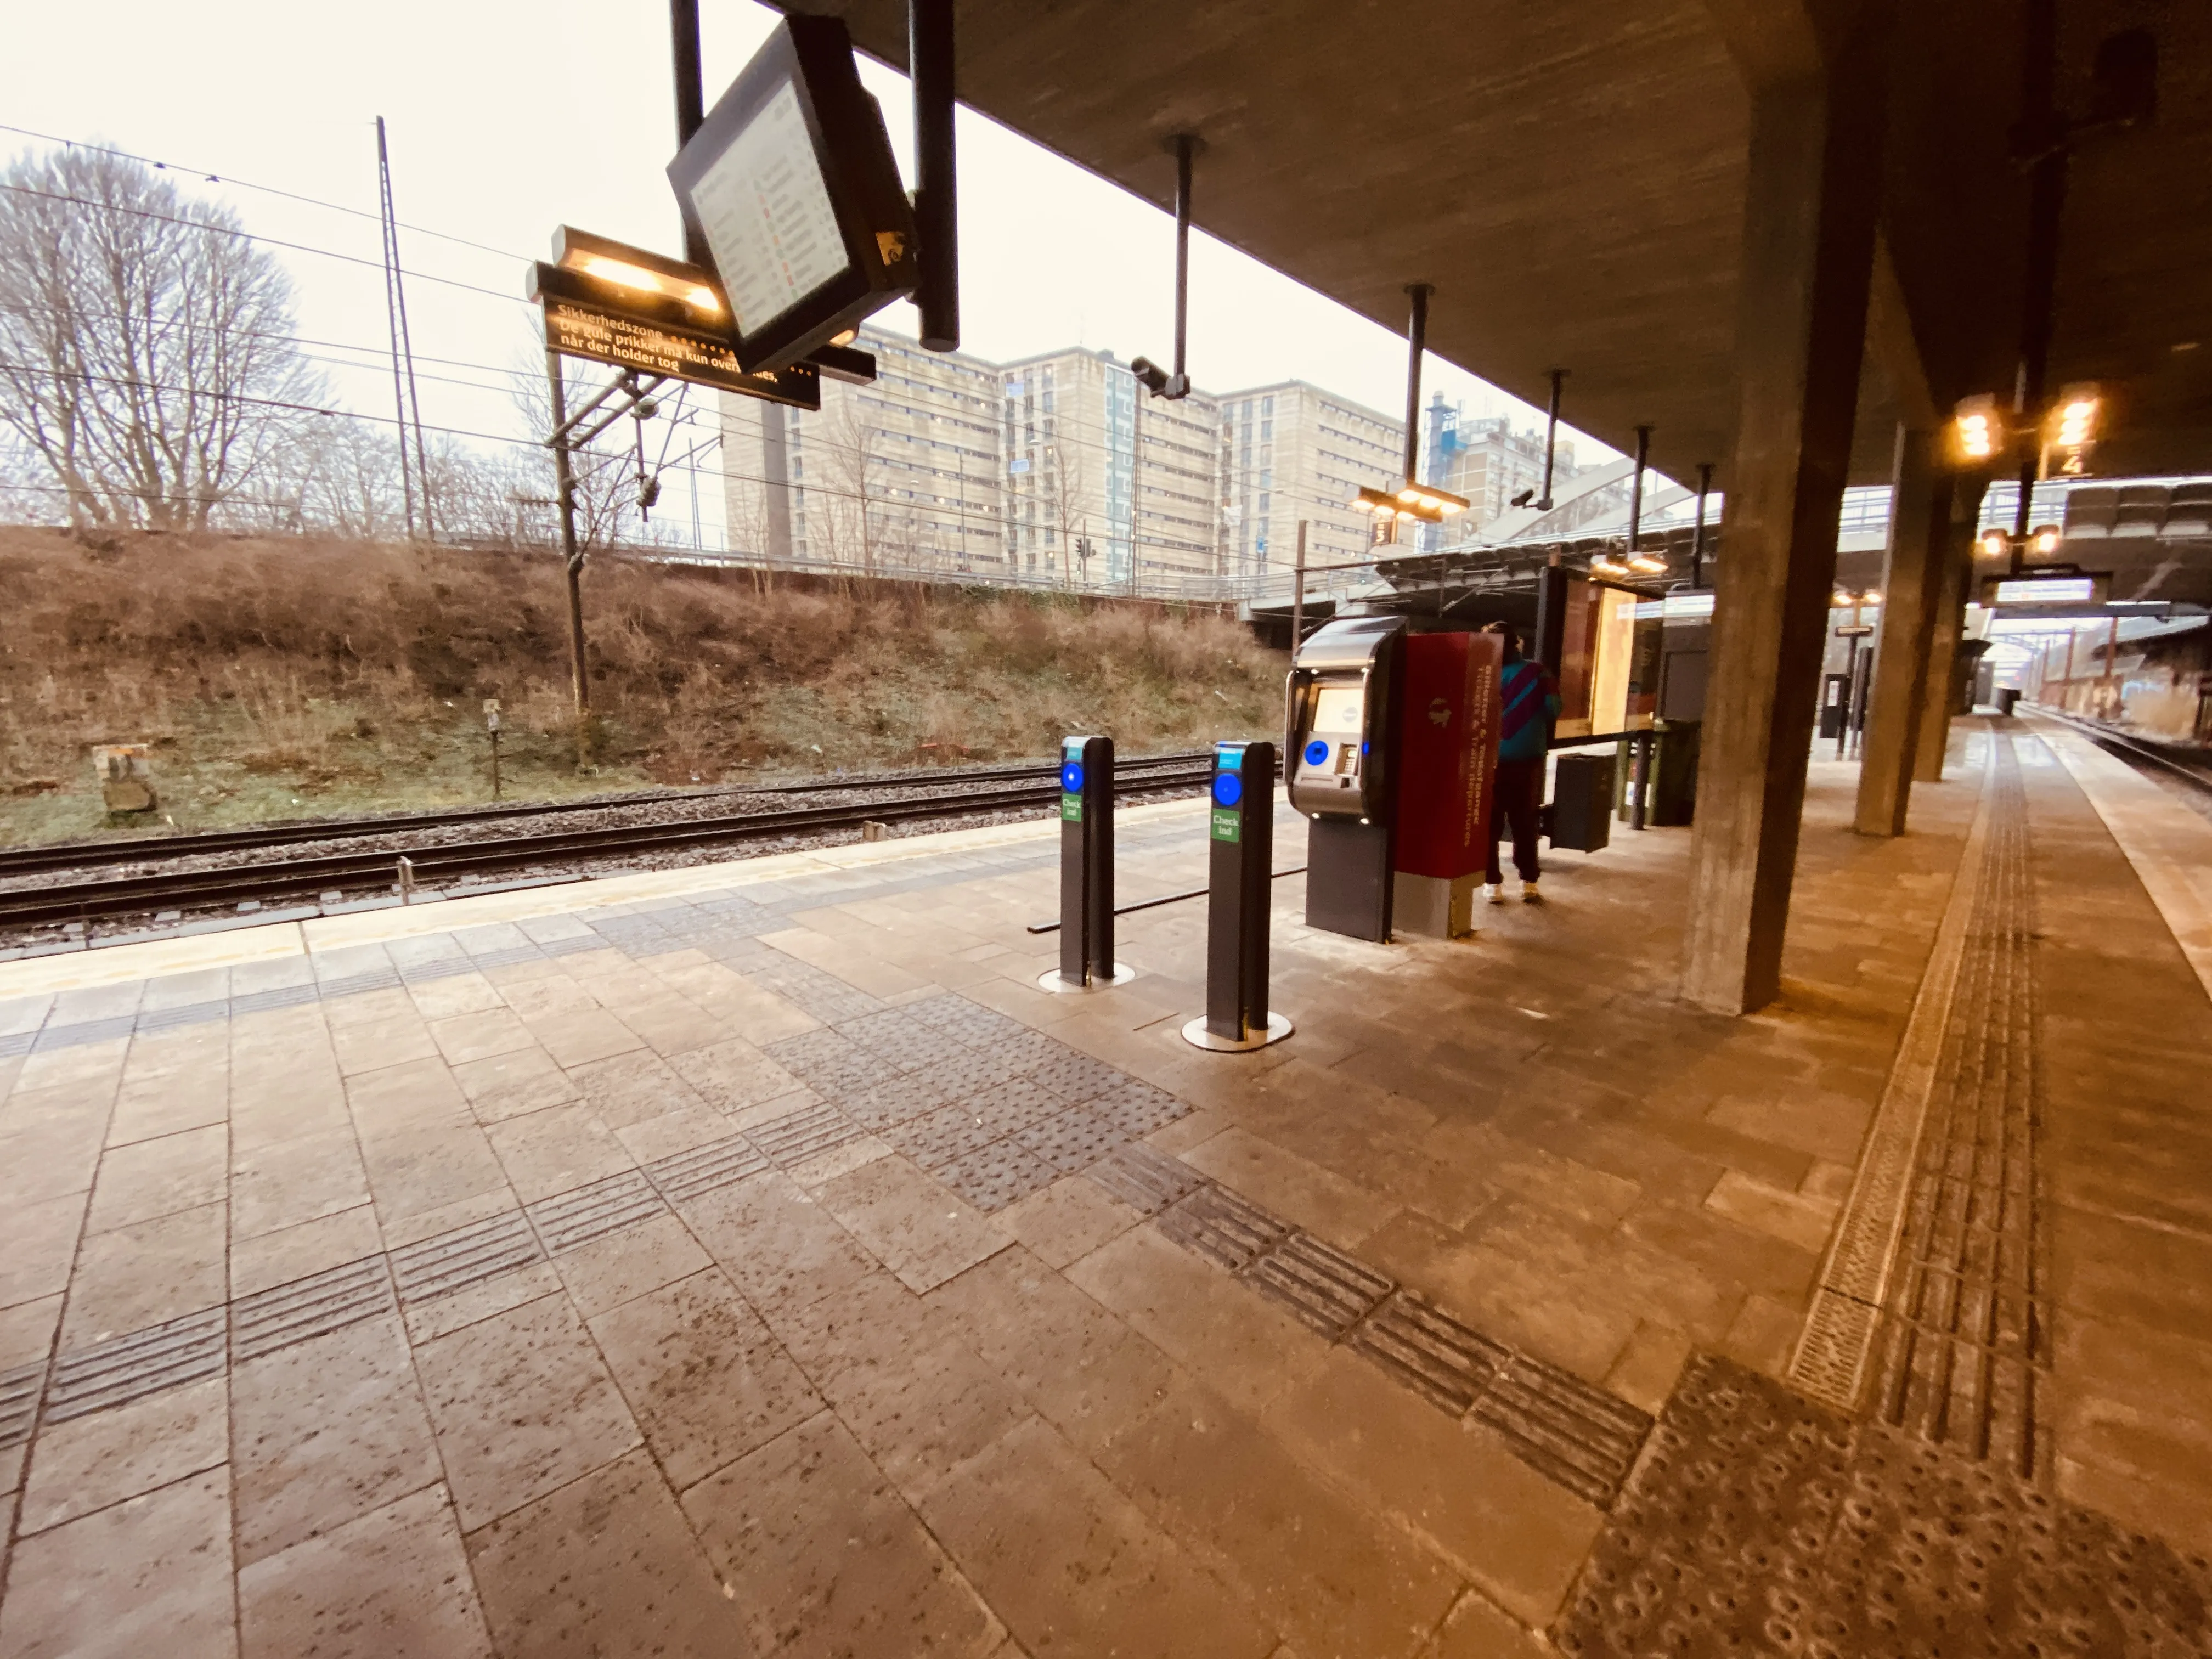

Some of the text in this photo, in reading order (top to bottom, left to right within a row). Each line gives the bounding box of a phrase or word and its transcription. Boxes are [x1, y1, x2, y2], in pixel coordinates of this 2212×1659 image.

[558, 304, 663, 339] Sikkerhedszone
[560, 320, 579, 334] De
[583, 324, 612, 342] gule
[616, 334, 661, 353] prikker
[664, 342, 682, 358] må
[686, 348, 709, 365] kun
[560, 334, 679, 373] når der holder tog
[2062, 455, 2082, 473] 4
[1063, 799, 1081, 808] Check
[1213, 815, 1239, 827] Check
[1218, 826, 1232, 836] ind
